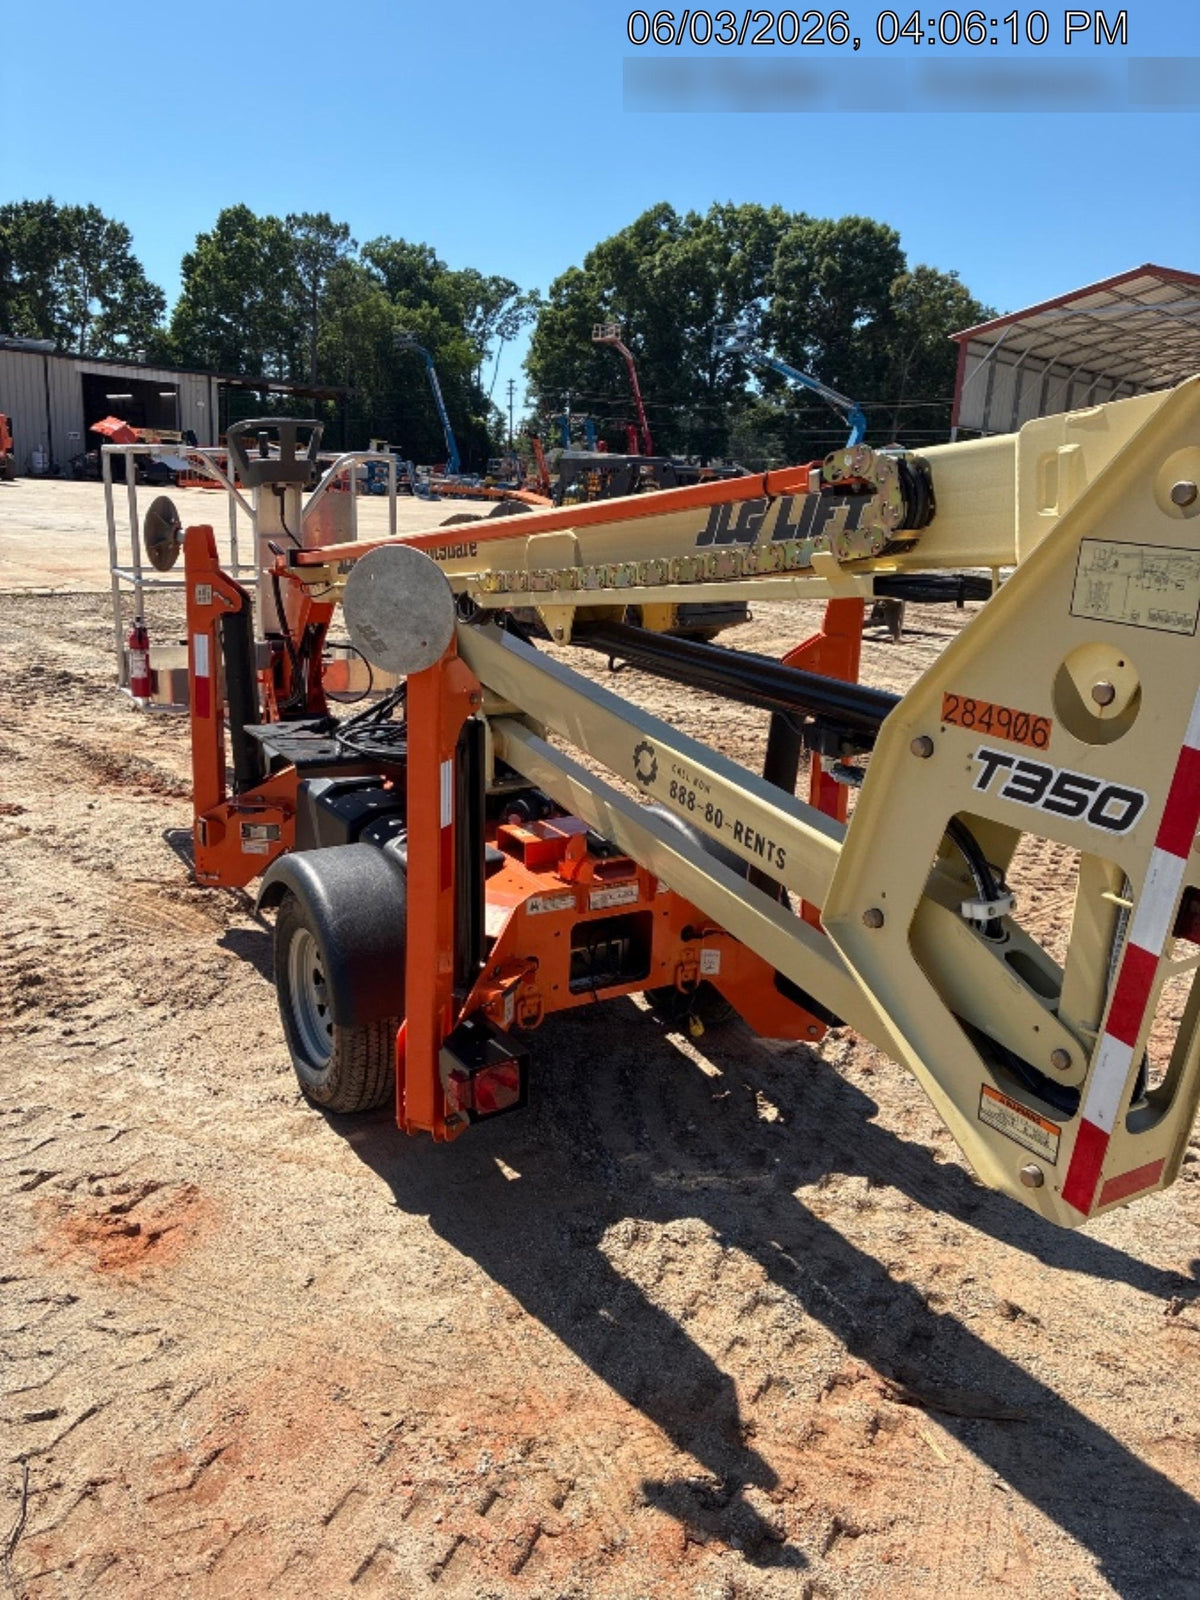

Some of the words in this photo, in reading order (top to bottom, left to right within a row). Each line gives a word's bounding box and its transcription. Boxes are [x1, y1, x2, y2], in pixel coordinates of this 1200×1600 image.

[696, 498, 768, 547] JLG
[771, 493, 874, 542] LIFT
[942, 693, 1050, 749] 284906
[669, 779, 787, 870] 888-80-RENTS
[973, 746, 1148, 834] T350
